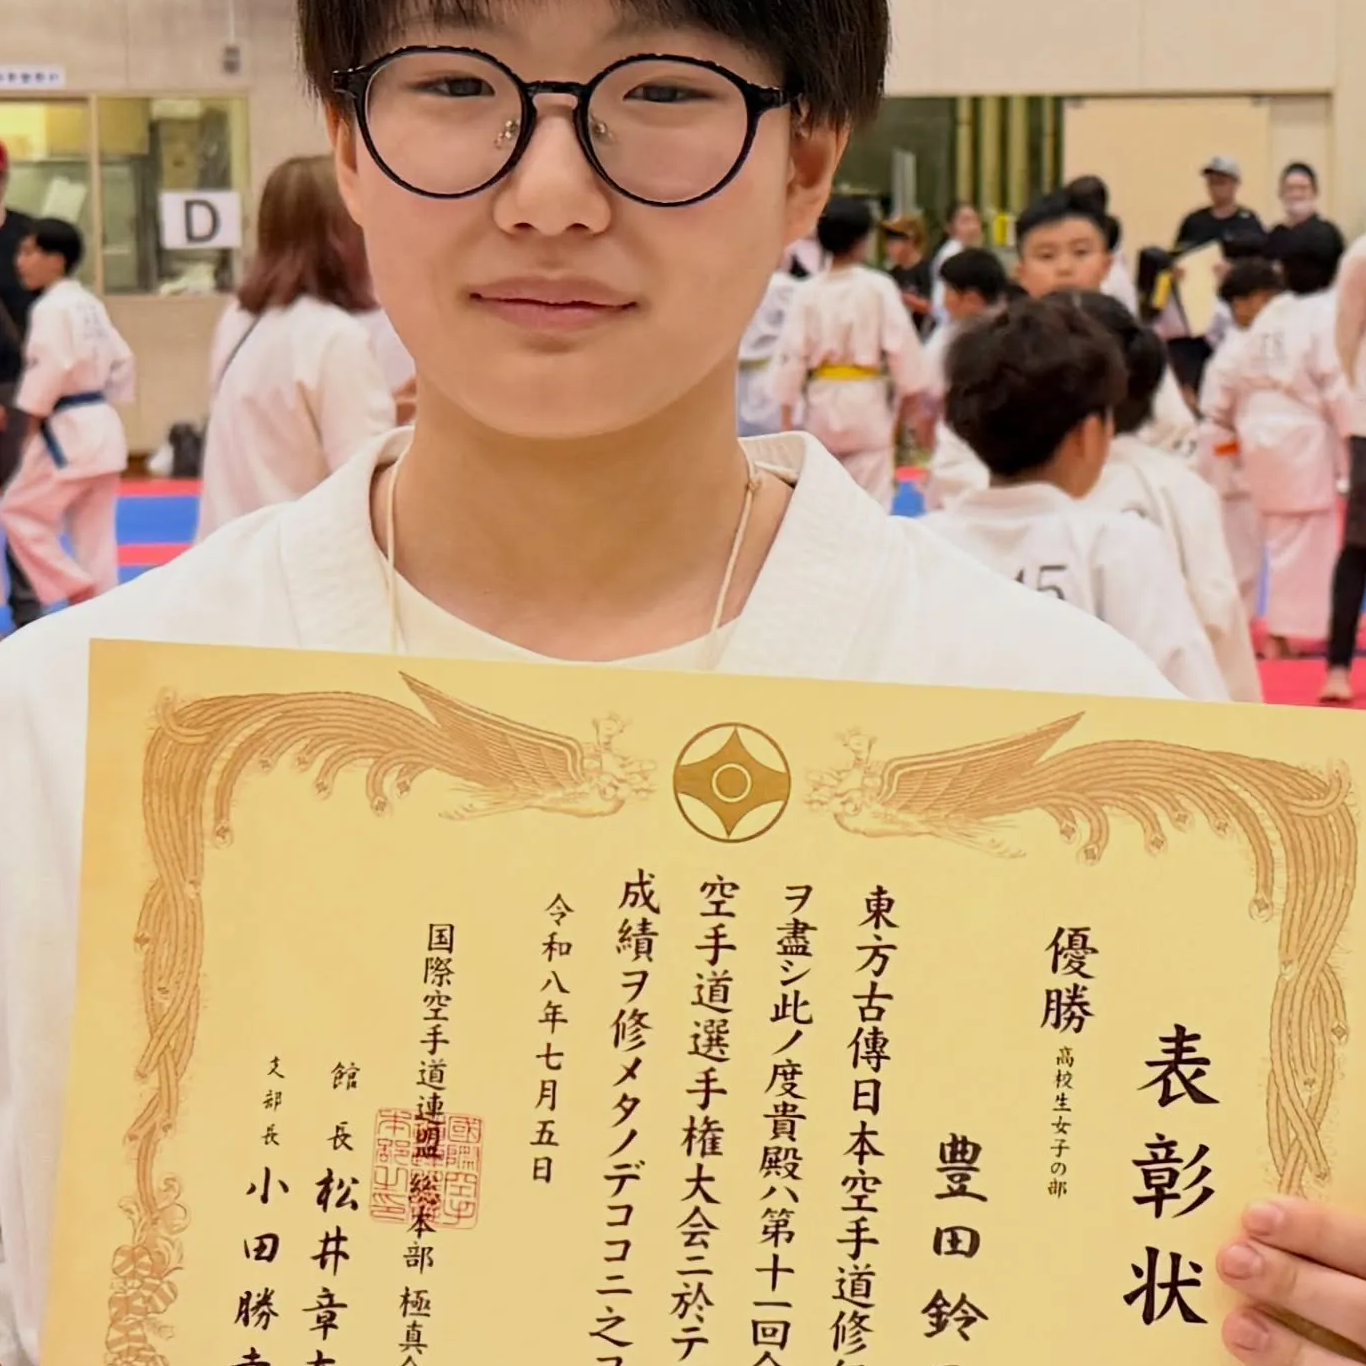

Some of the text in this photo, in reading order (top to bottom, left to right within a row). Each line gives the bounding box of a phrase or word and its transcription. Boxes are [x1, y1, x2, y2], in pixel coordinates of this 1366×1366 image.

[184, 199, 221, 243] D
[529, 892, 575, 1184] 令和八年七月五日
[1040, 926, 1099, 1198] 優勝 高校生女子の部
[1122, 1023, 1220, 1326] 表彰状
